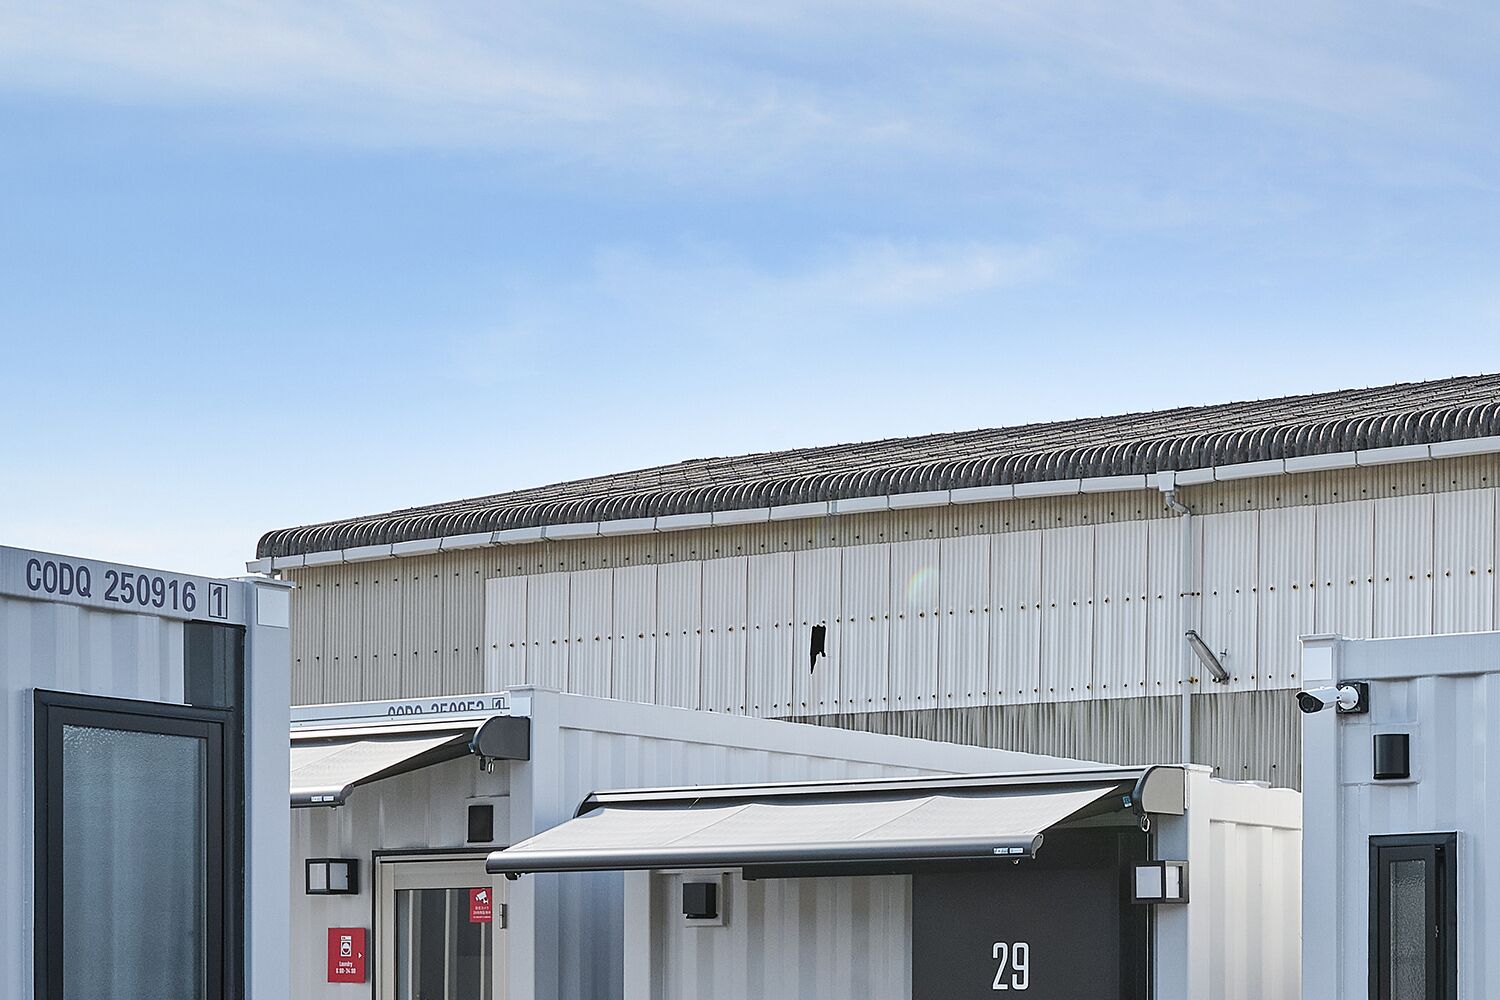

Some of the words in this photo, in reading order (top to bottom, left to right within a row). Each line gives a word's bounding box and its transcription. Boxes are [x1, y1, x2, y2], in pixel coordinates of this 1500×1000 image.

[26, 558, 92, 599] CODQ
[104, 569, 197, 612] 250916
[211, 585, 225, 618] 1
[992, 942, 1029, 990] 29
